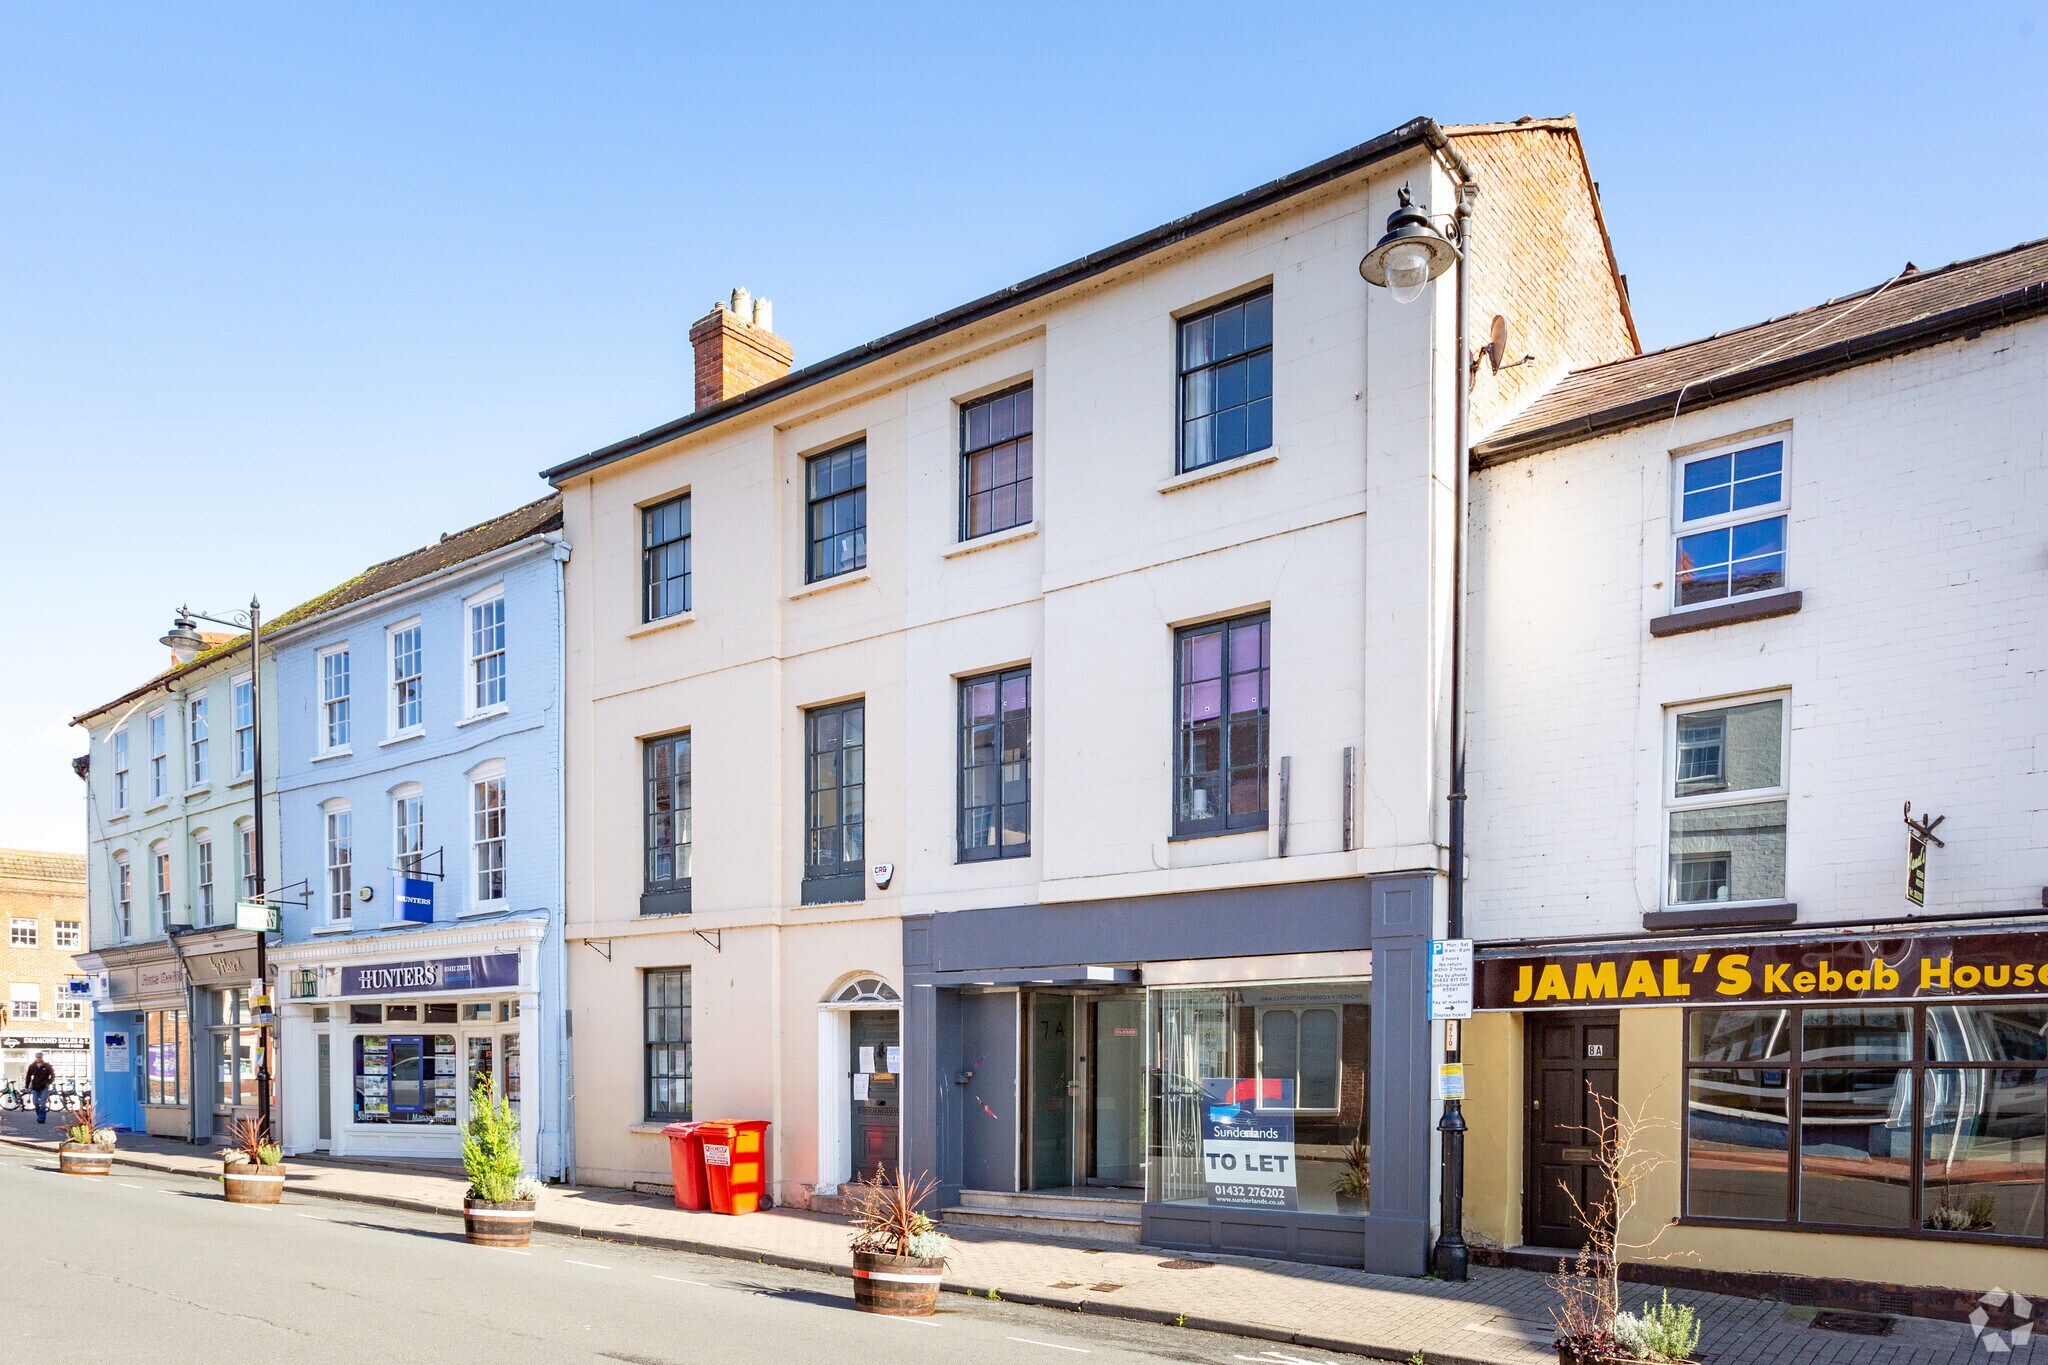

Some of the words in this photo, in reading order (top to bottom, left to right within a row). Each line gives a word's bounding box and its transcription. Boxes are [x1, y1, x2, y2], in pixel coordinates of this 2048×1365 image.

[396, 895, 431, 905] HUNTERS
[358, 966, 436, 988] HUNTERS
[1514, 954, 1752, 1002] JAMAL'S
[1764, 958, 1899, 993] Kebab
[1590, 1046, 1601, 1055] 8A
[358, 1111, 373, 1121] Sales
[412, 1114, 452, 1123] Management
[1214, 1126, 1278, 1139] Sunderlands
[1206, 1152, 1237, 1170] TO
[1245, 1154, 1289, 1172] LET
[1215, 1185, 1245, 1196] 01432
[1247, 1187, 1285, 1198] 276202
[1216, 1197, 1285, 1206] www.sunderlands.co.uk
